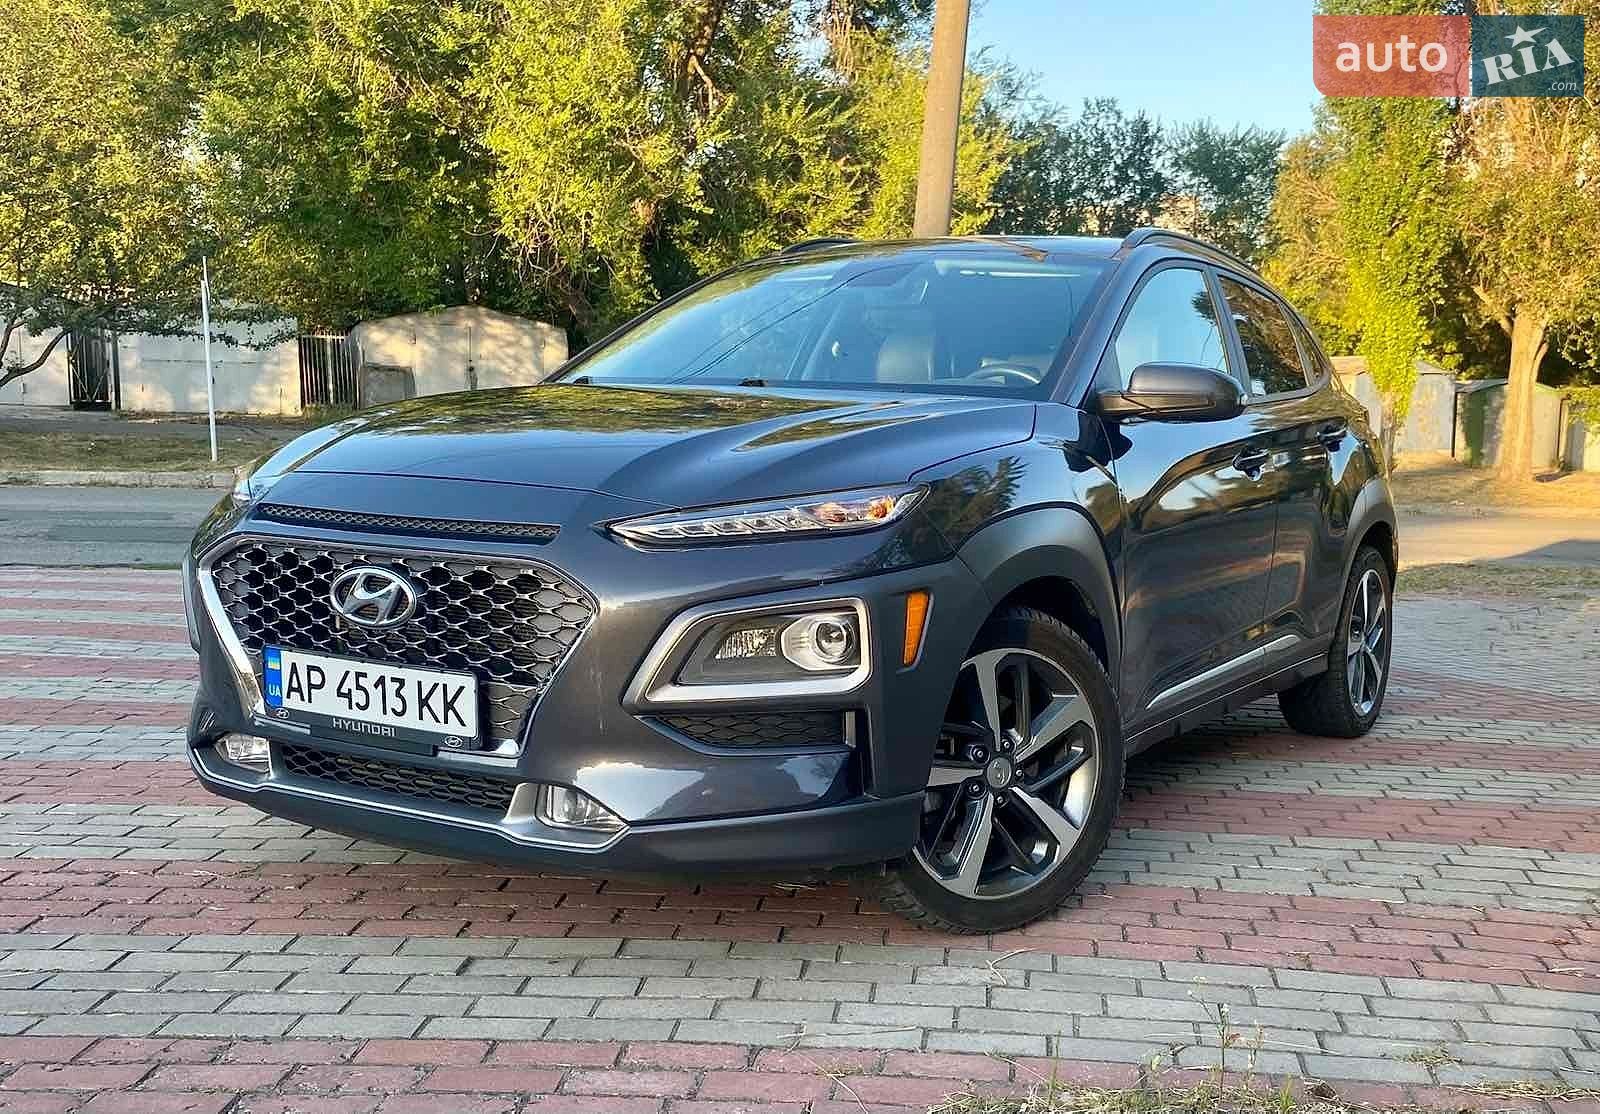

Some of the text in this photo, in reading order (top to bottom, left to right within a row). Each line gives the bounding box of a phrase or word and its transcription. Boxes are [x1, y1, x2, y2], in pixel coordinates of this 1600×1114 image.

[269, 685, 282, 697] UA
[286, 662, 466, 727] AP 4513 KK
[332, 717, 397, 737] HYUNDAI
